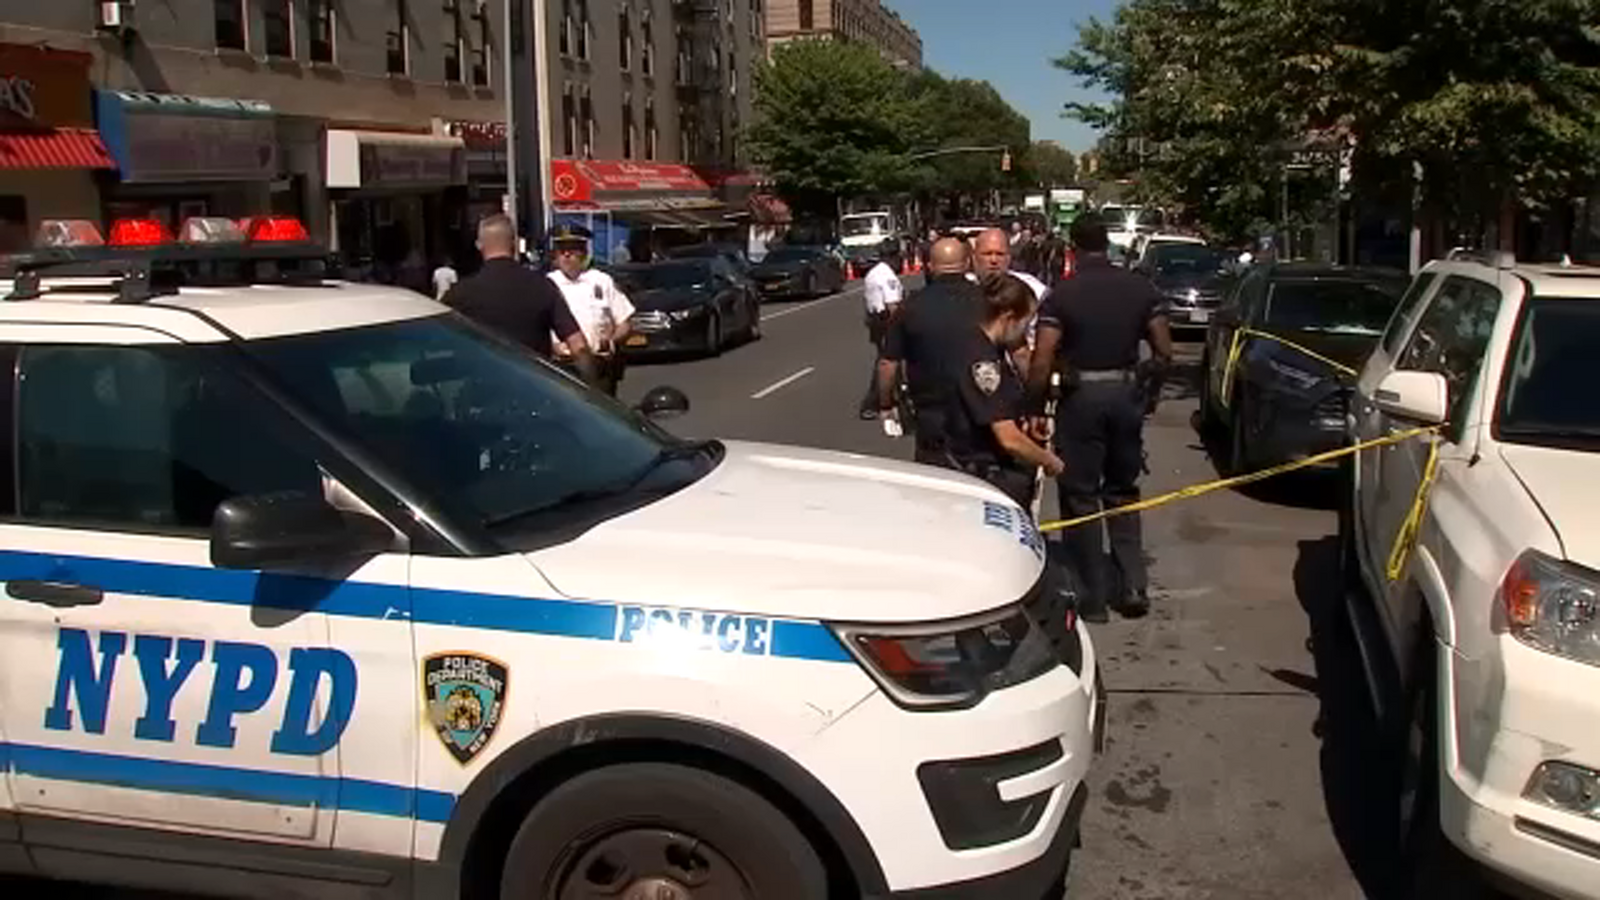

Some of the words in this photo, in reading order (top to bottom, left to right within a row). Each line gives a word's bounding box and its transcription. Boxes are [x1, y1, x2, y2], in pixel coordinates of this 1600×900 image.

[618, 605, 768, 655] PICE
[428, 670, 504, 692] DEPARTMENT
[443, 657, 490, 673] POLICE
[44, 627, 358, 756] NYPD
